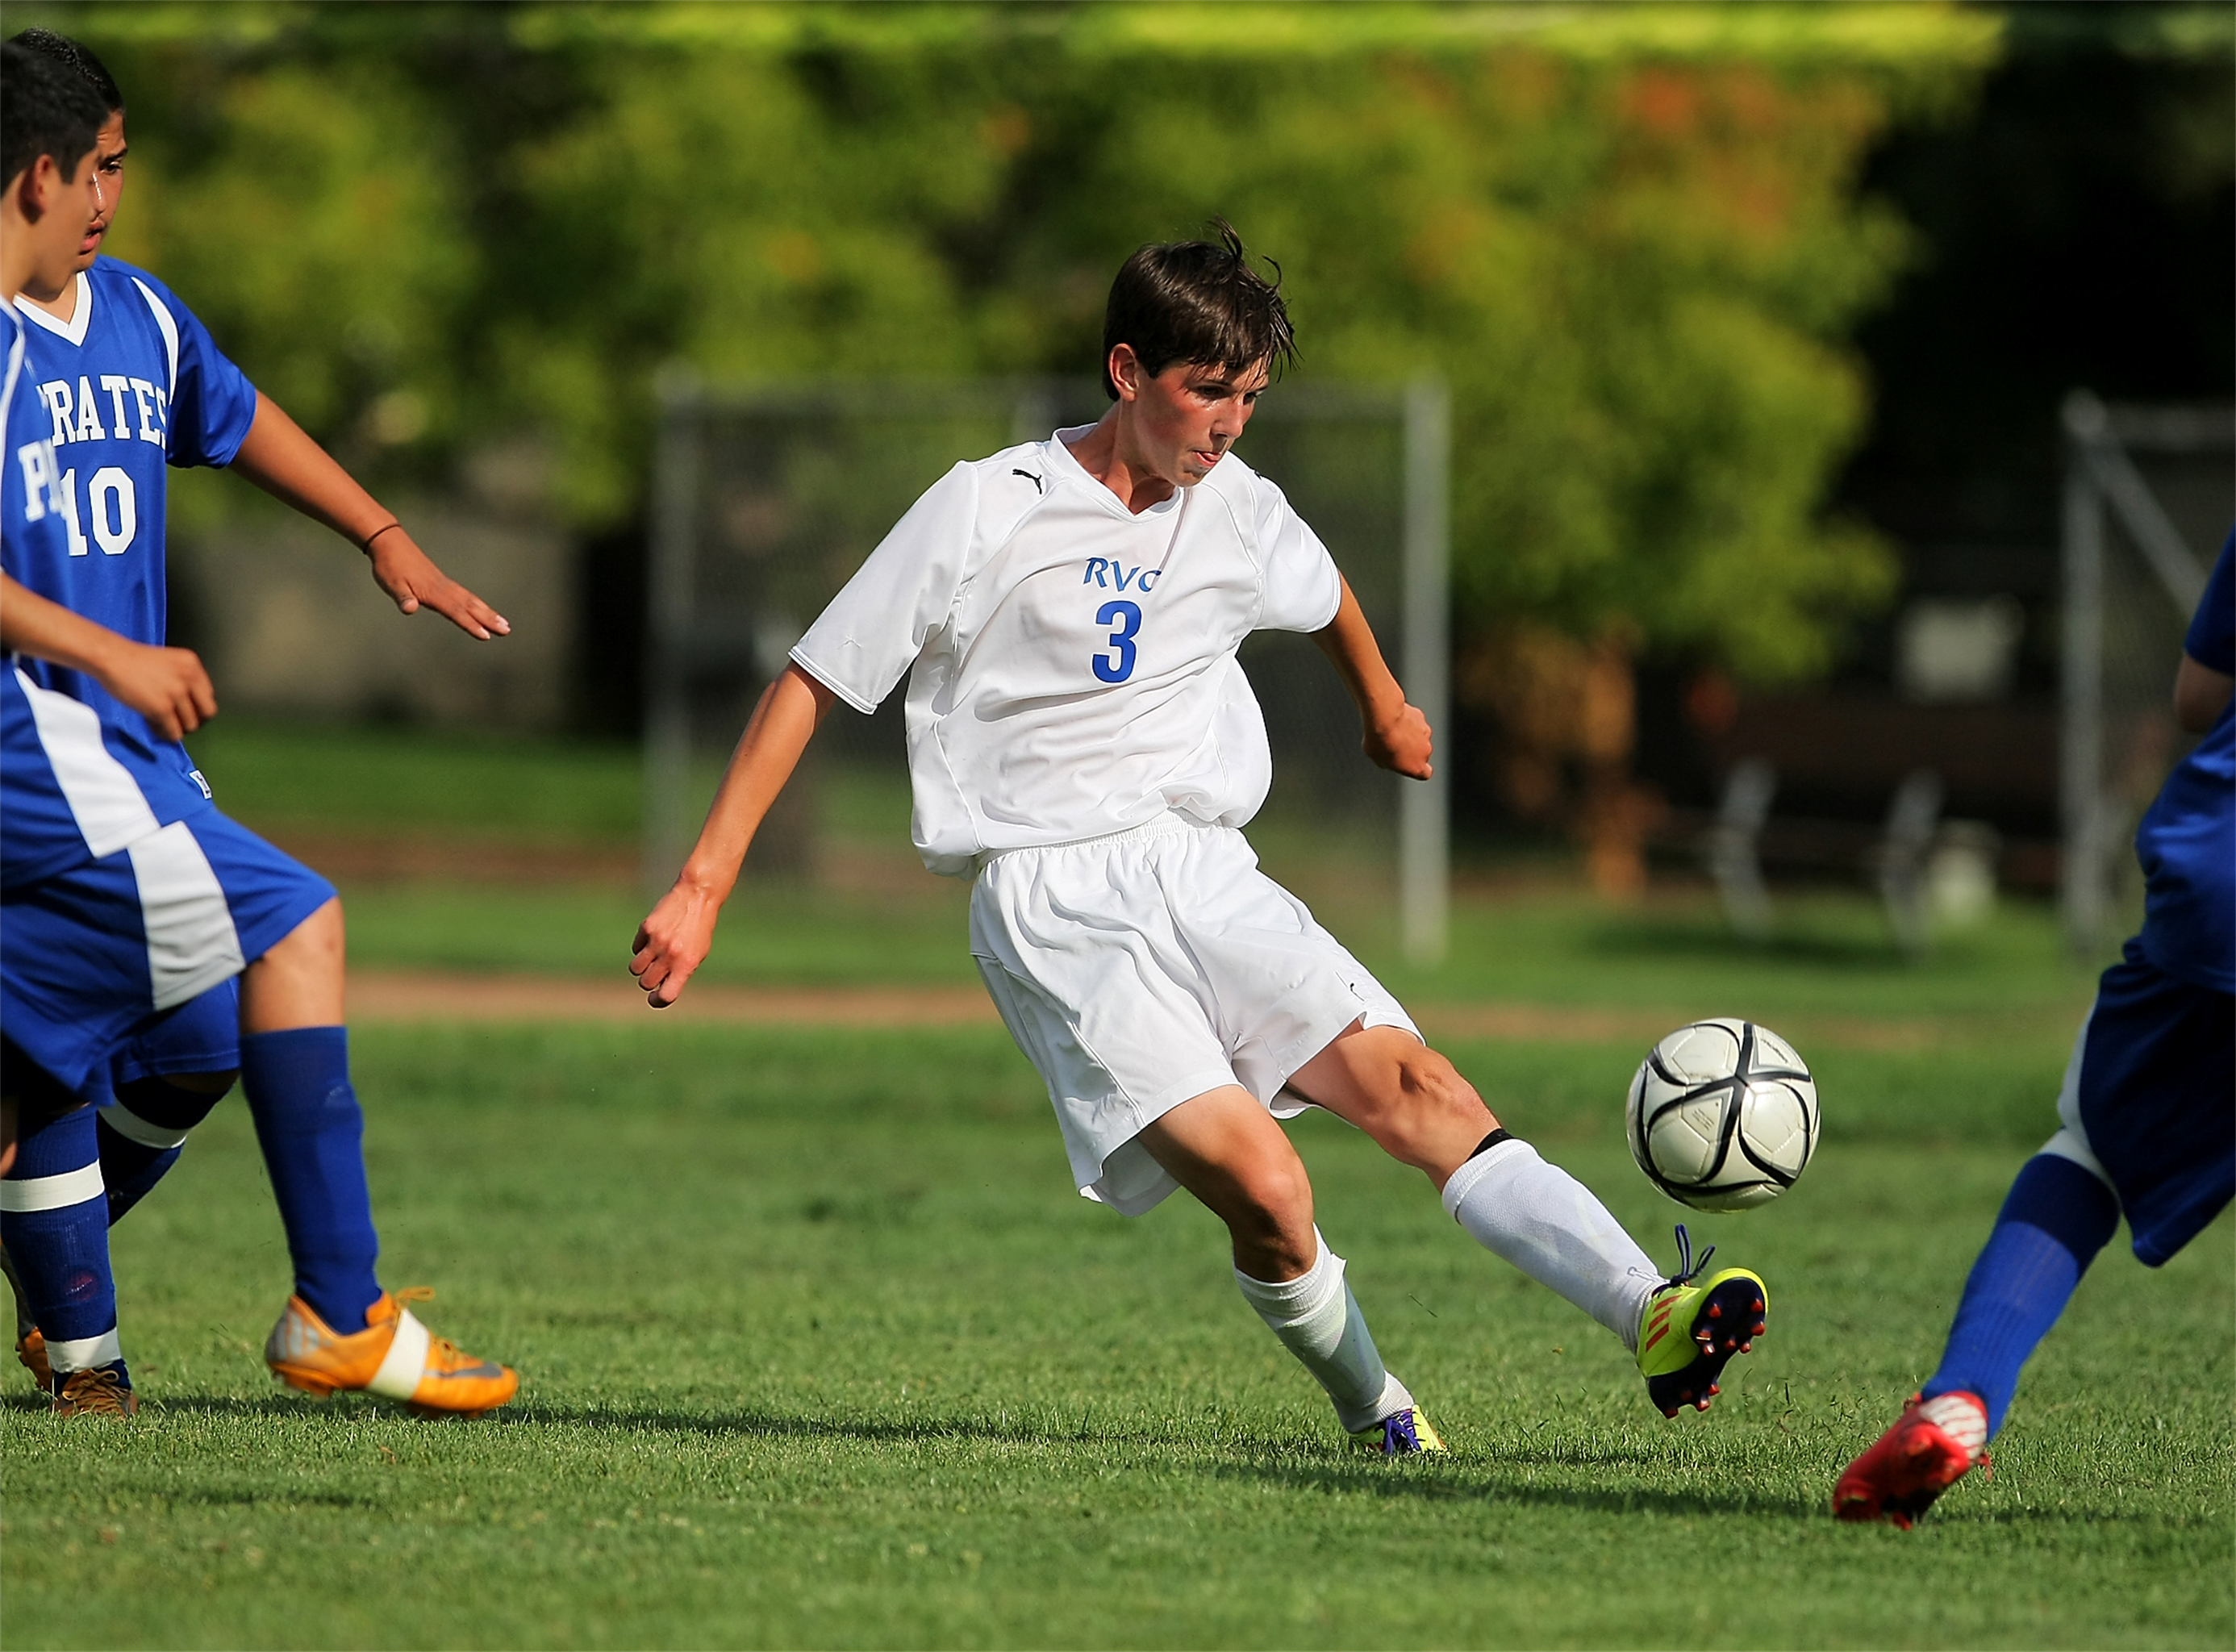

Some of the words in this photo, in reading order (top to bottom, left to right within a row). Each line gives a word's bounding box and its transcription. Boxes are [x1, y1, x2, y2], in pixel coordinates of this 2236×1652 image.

[36, 374, 166, 450] RATES
[60, 467, 136, 555] 10
[1091, 600, 1142, 683] 3
